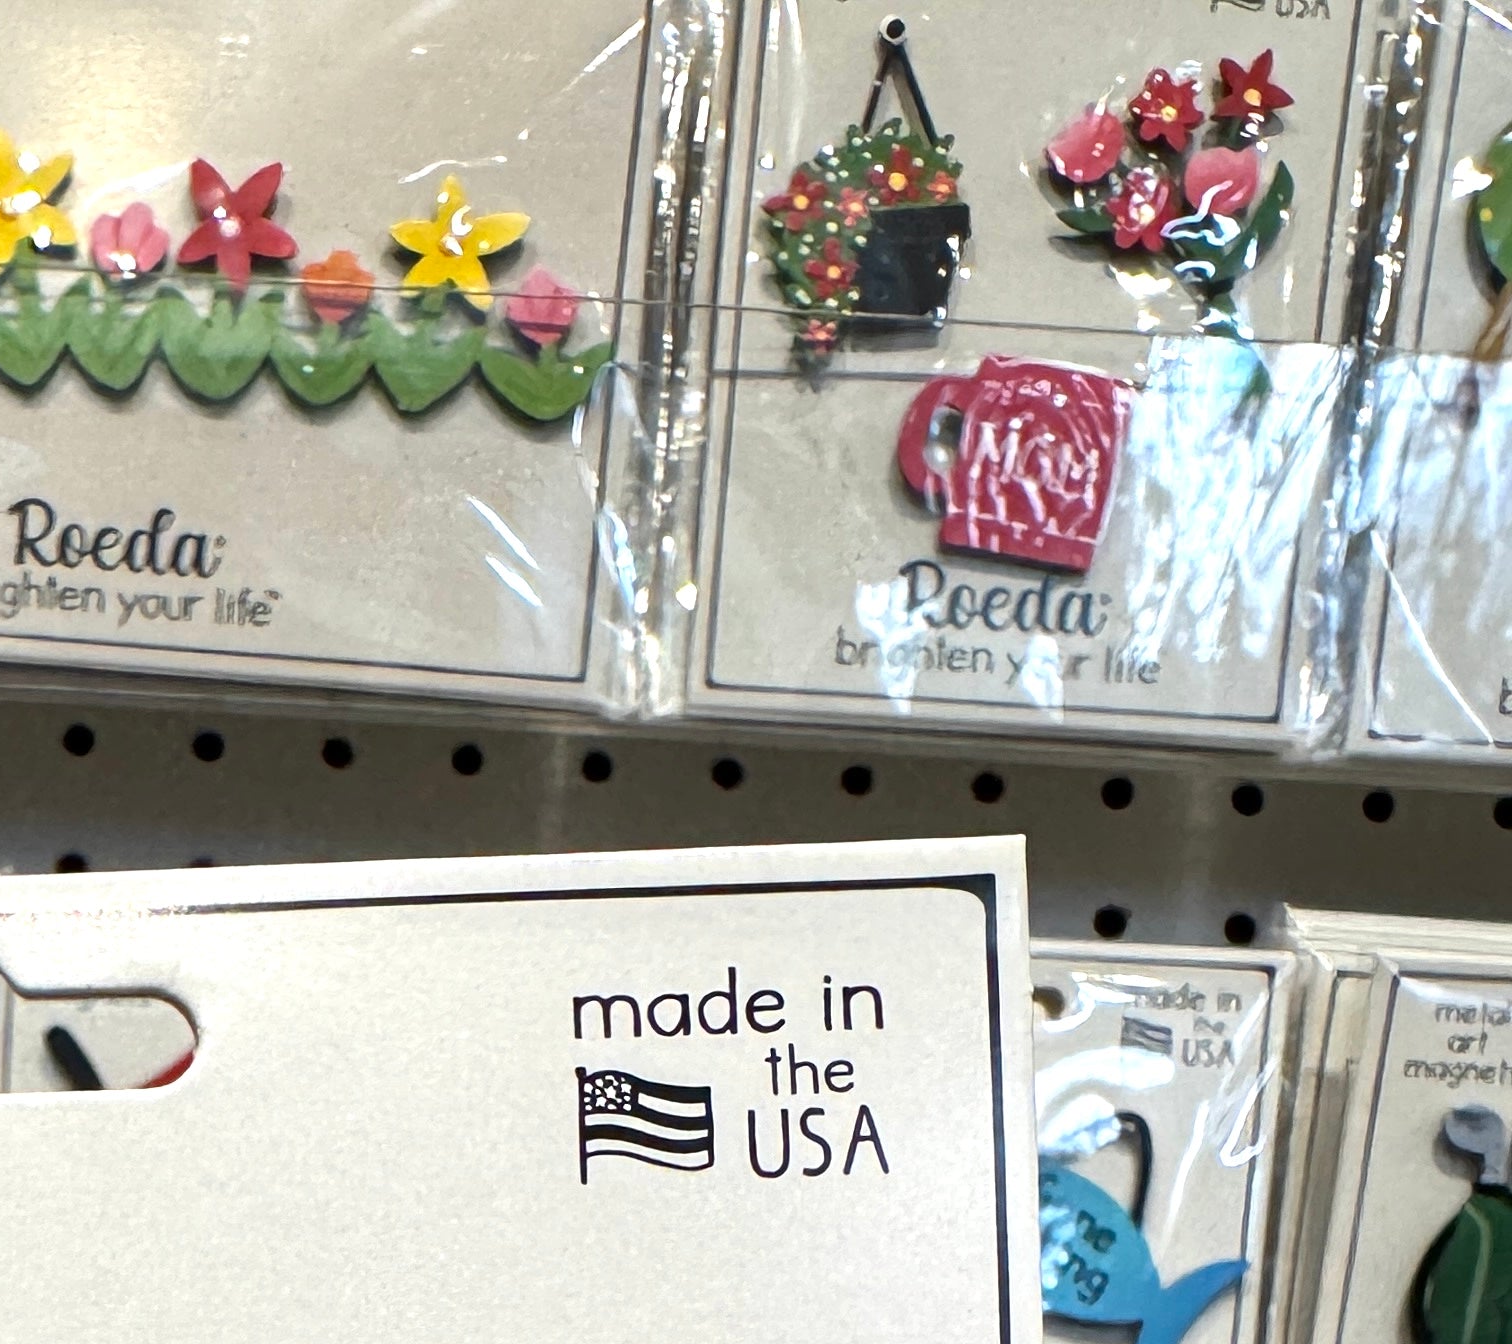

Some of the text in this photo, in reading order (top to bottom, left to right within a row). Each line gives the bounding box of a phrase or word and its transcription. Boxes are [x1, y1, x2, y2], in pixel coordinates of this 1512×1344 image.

[117, 589, 204, 627] your
[572, 966, 885, 1040] made in
[764, 1042, 855, 1096] the
[1403, 1058, 1512, 1089] magnet
[747, 1104, 890, 1179] USA
